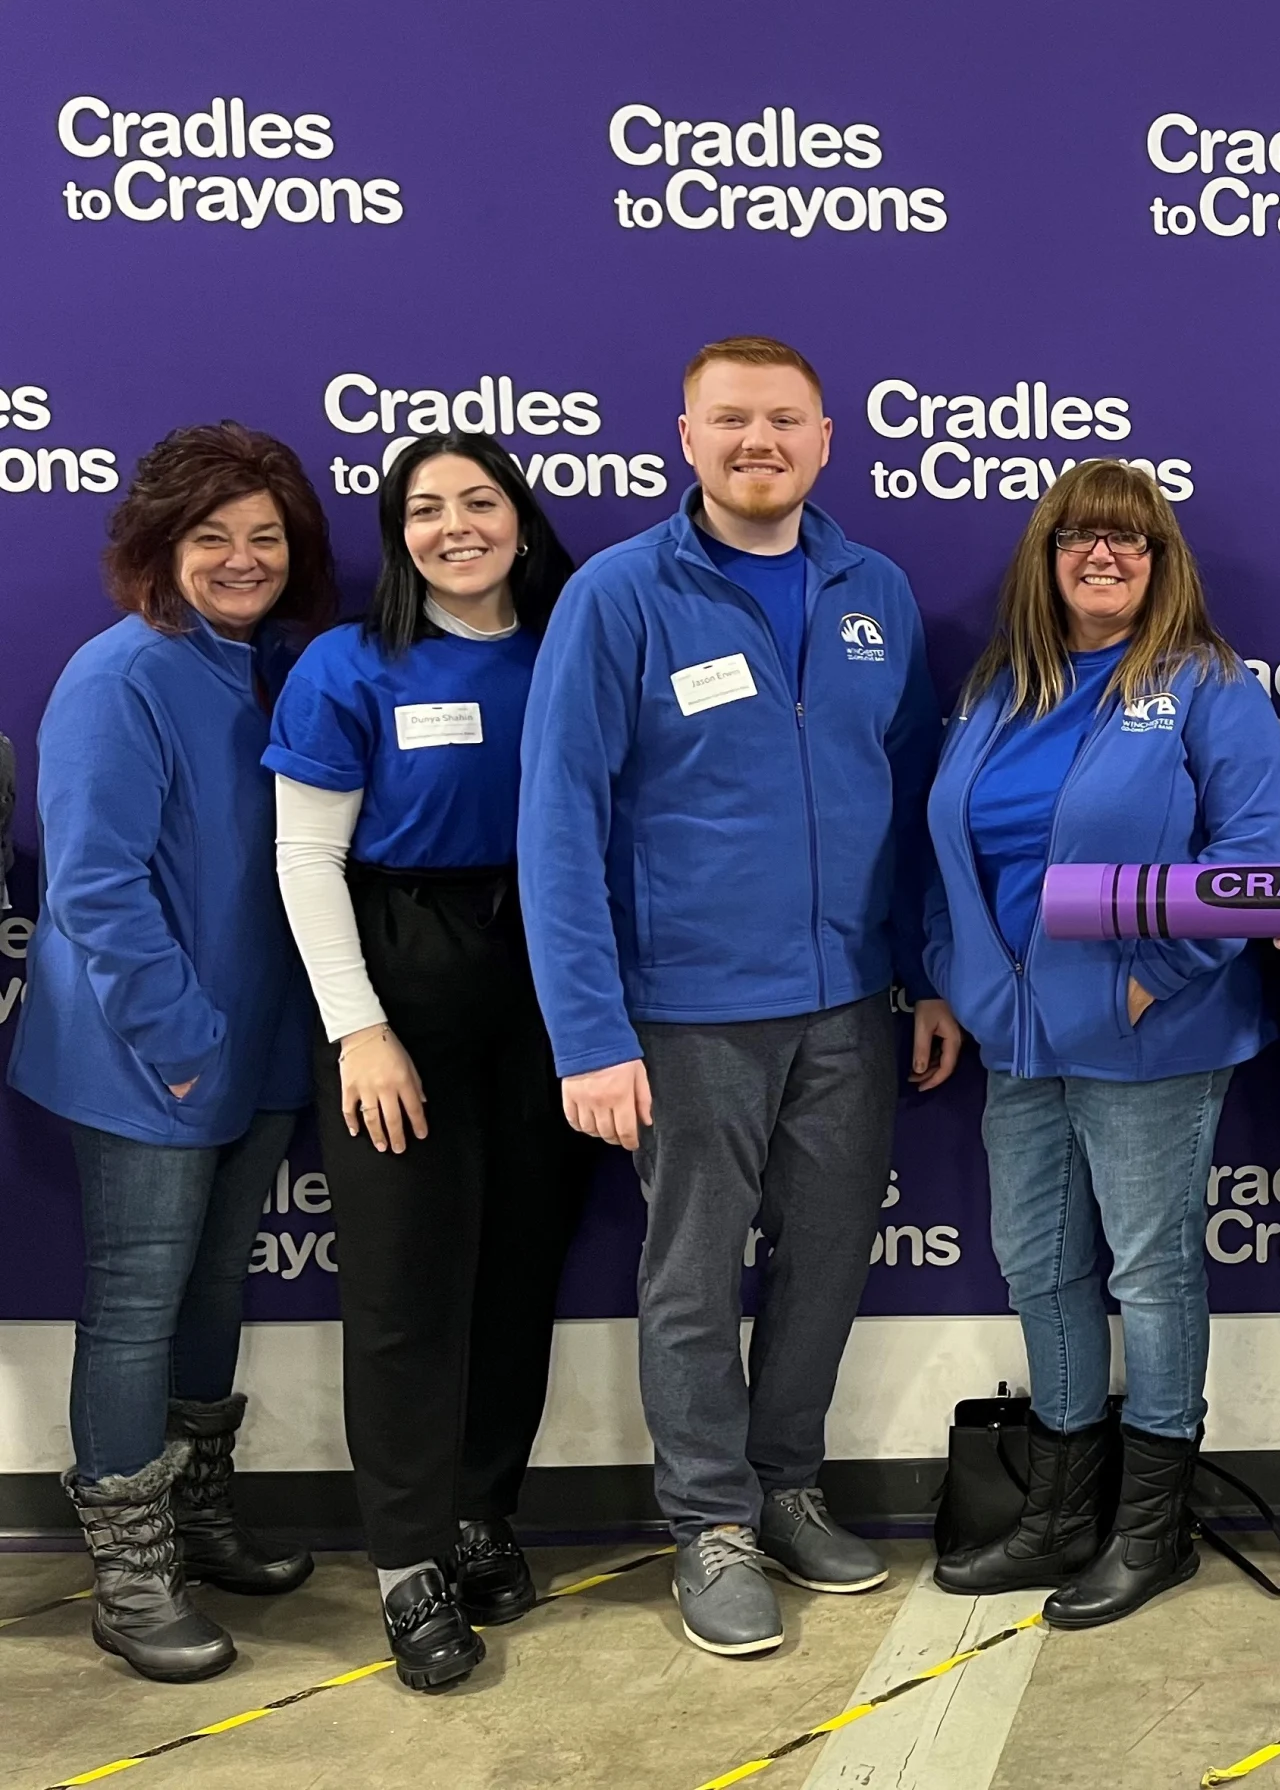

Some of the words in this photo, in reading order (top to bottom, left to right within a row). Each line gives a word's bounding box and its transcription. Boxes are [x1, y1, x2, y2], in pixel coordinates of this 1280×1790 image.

[59, 96, 333, 160] Cradles
[610, 104, 882, 169] Cradles
[62, 181, 112, 221] to
[113, 159, 403, 230] Crayons
[613, 189, 663, 228] to
[665, 168, 948, 240] Crayons
[1150, 197, 1197, 237] to
[324, 373, 601, 436] Cradles
[867, 379, 1132, 441] Cradles
[330, 456, 380, 496] to
[871, 461, 918, 499] to
[691, 675, 716, 688] Jason
